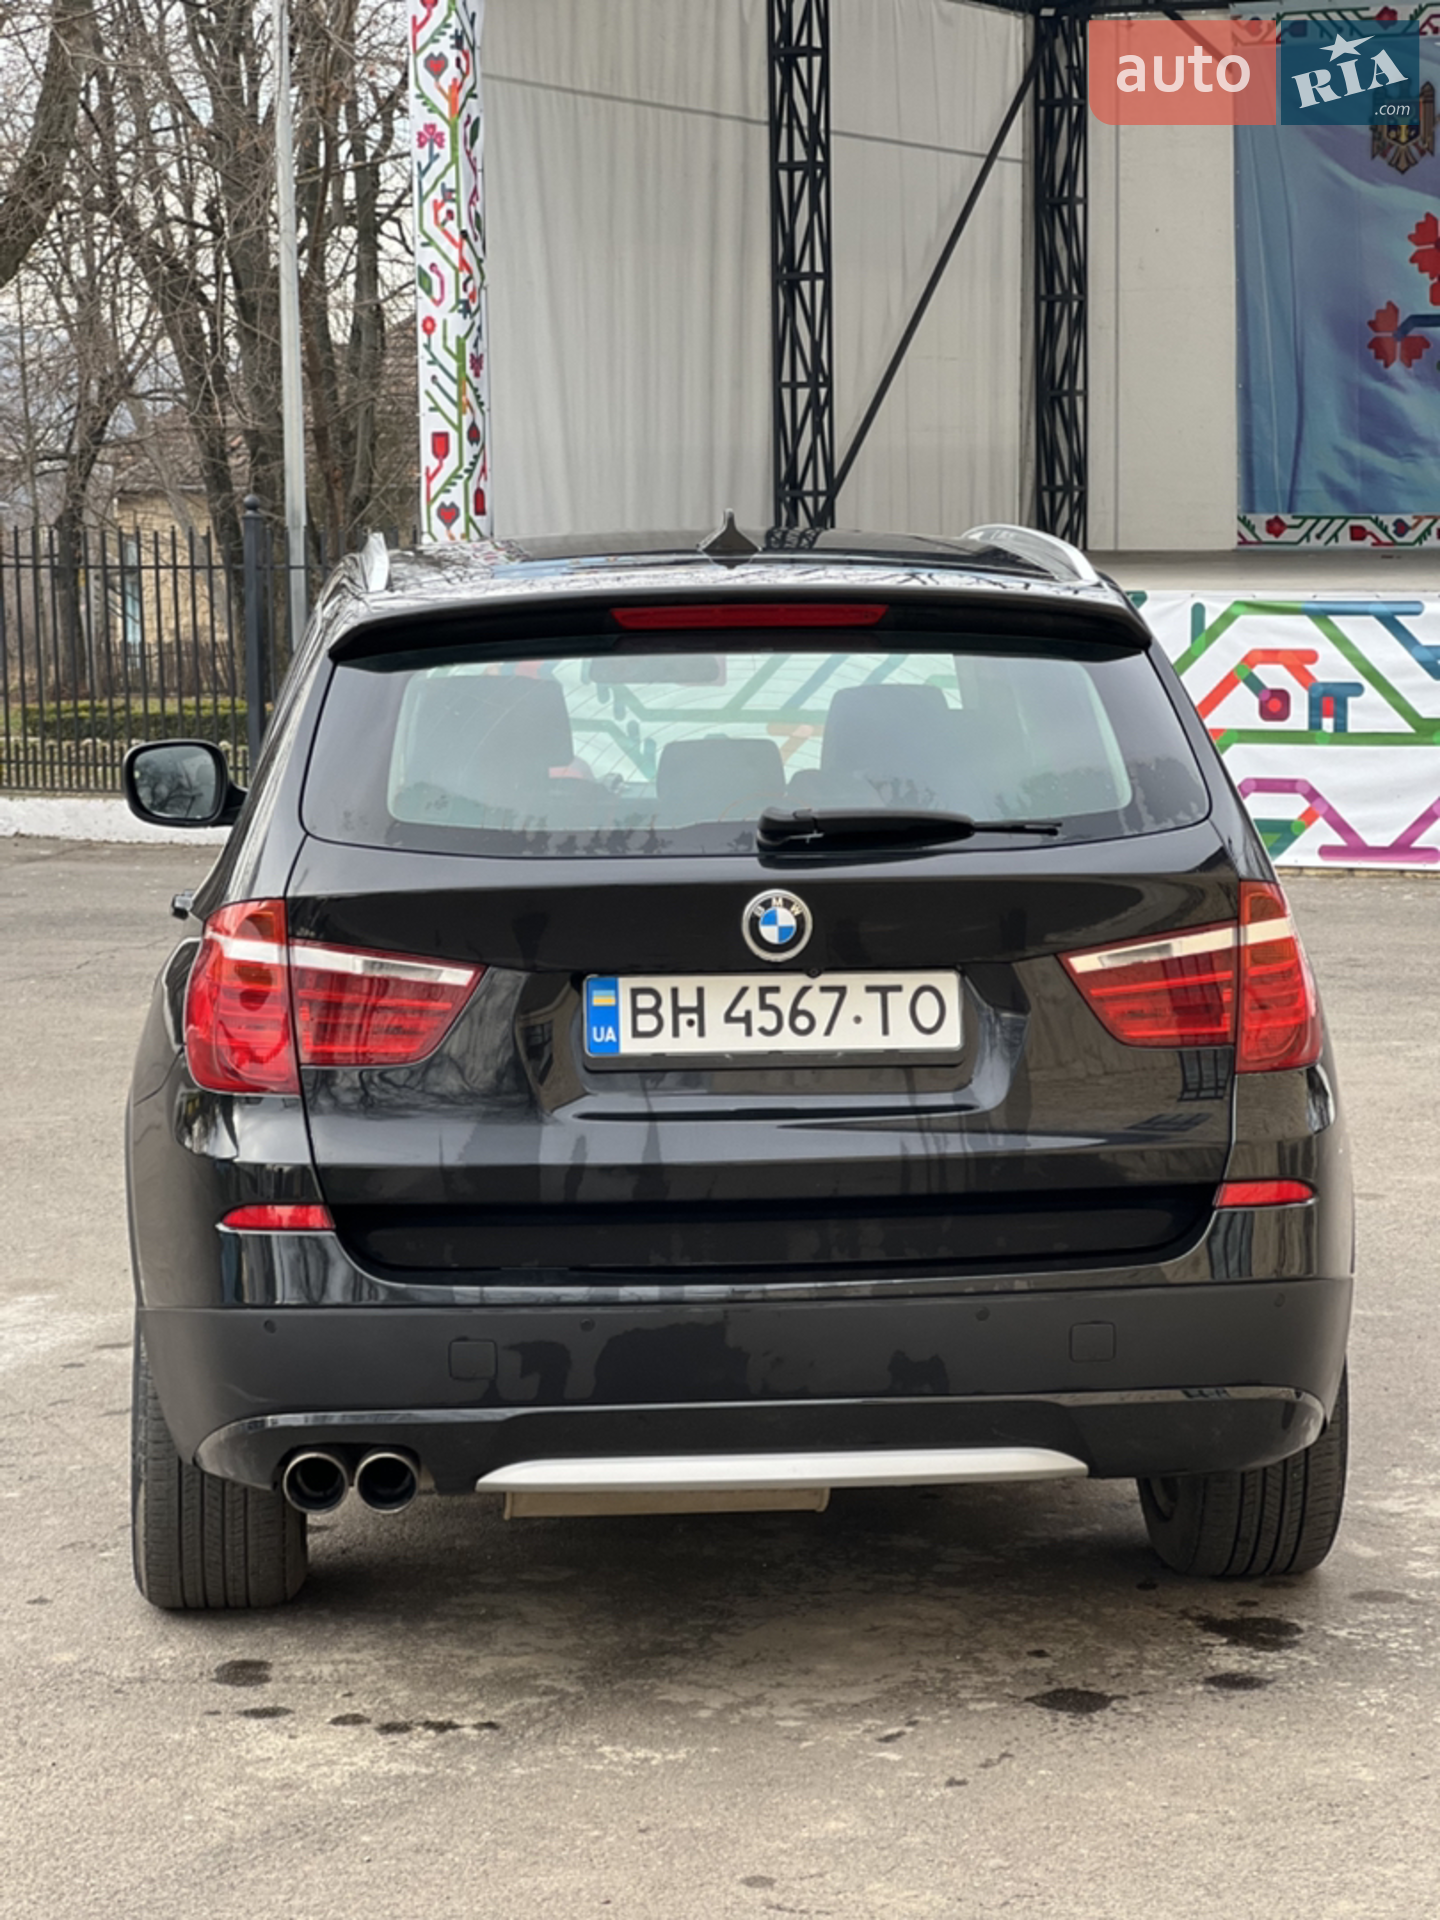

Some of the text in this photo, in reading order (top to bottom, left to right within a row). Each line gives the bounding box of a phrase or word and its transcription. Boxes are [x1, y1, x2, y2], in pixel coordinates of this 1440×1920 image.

[629, 984, 946, 1038] BH 4567 TO
[592, 1026, 617, 1043] UA
